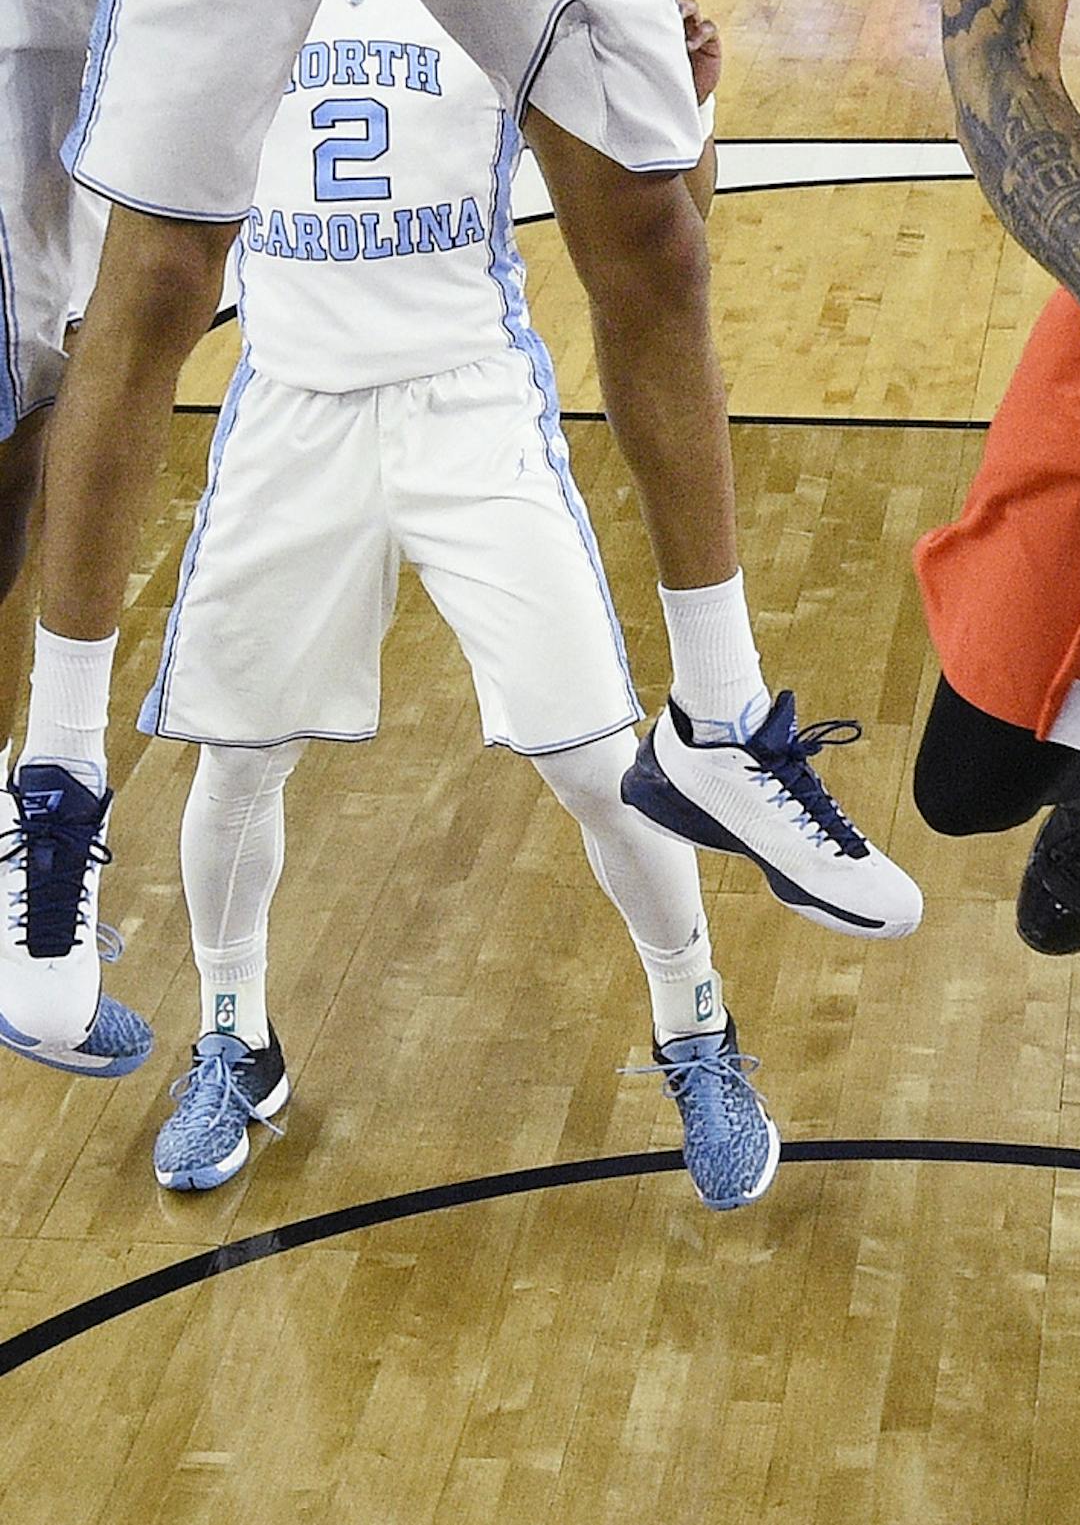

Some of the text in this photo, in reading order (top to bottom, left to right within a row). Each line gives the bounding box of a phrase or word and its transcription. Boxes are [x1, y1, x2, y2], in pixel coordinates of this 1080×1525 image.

[284, 39, 442, 96] ORTH
[311, 97, 392, 202] 2
[248, 196, 485, 262] CAROLINA
